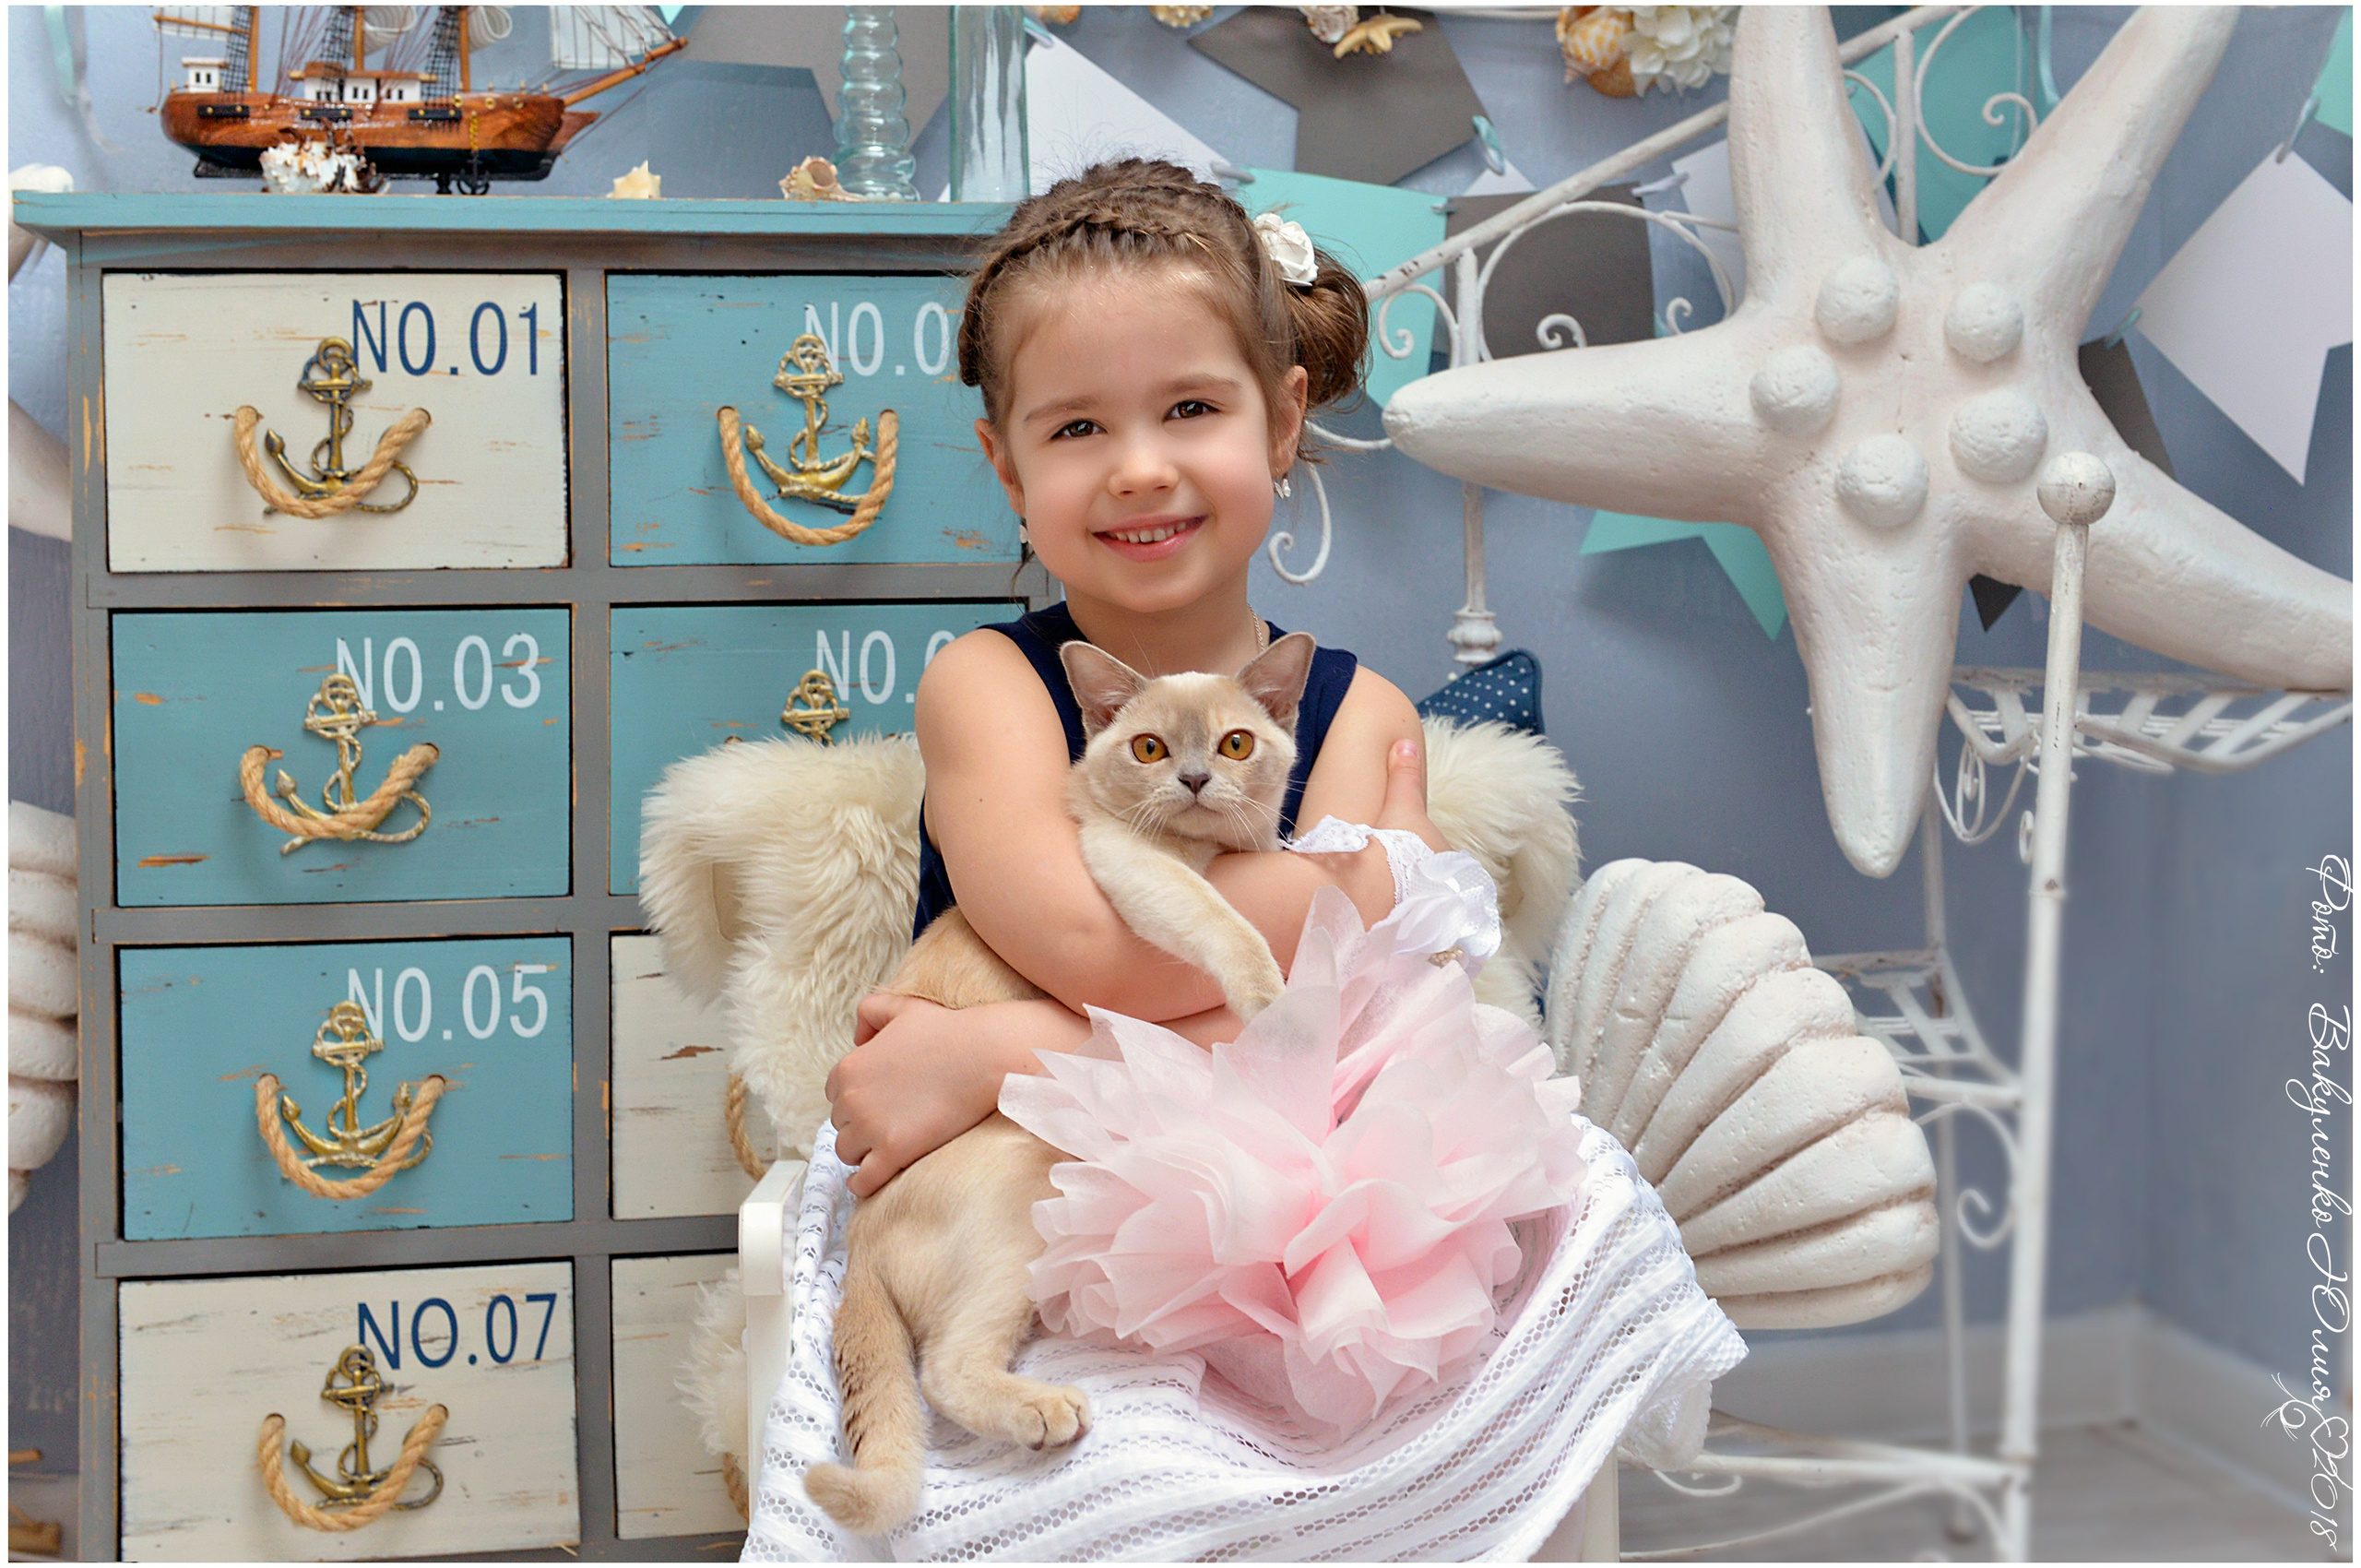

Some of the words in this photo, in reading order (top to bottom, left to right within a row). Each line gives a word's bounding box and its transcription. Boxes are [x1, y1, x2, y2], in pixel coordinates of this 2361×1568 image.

[351, 299, 540, 376] NO.01
[336, 633, 542, 713] NO.03
[347, 964, 550, 1043] NO.05
[357, 1292, 558, 1371] NO.07
